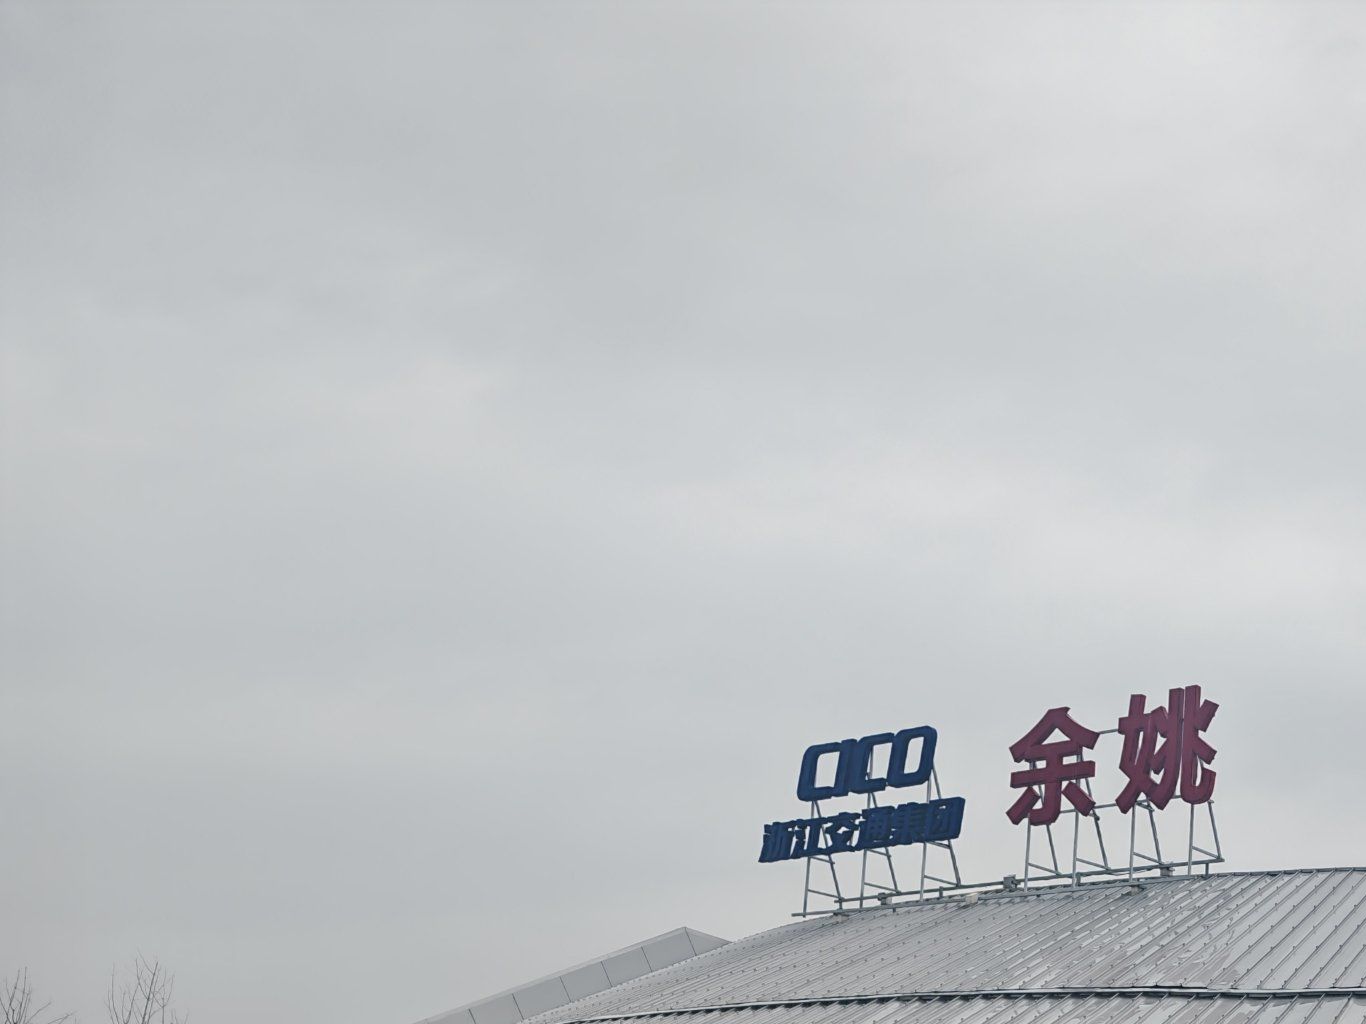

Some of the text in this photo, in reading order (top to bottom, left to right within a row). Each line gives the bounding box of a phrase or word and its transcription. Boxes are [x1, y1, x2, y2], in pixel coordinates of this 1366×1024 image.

[1006, 684, 1220, 826] 余姚
[758, 796, 966, 863] 浙江交通集团
